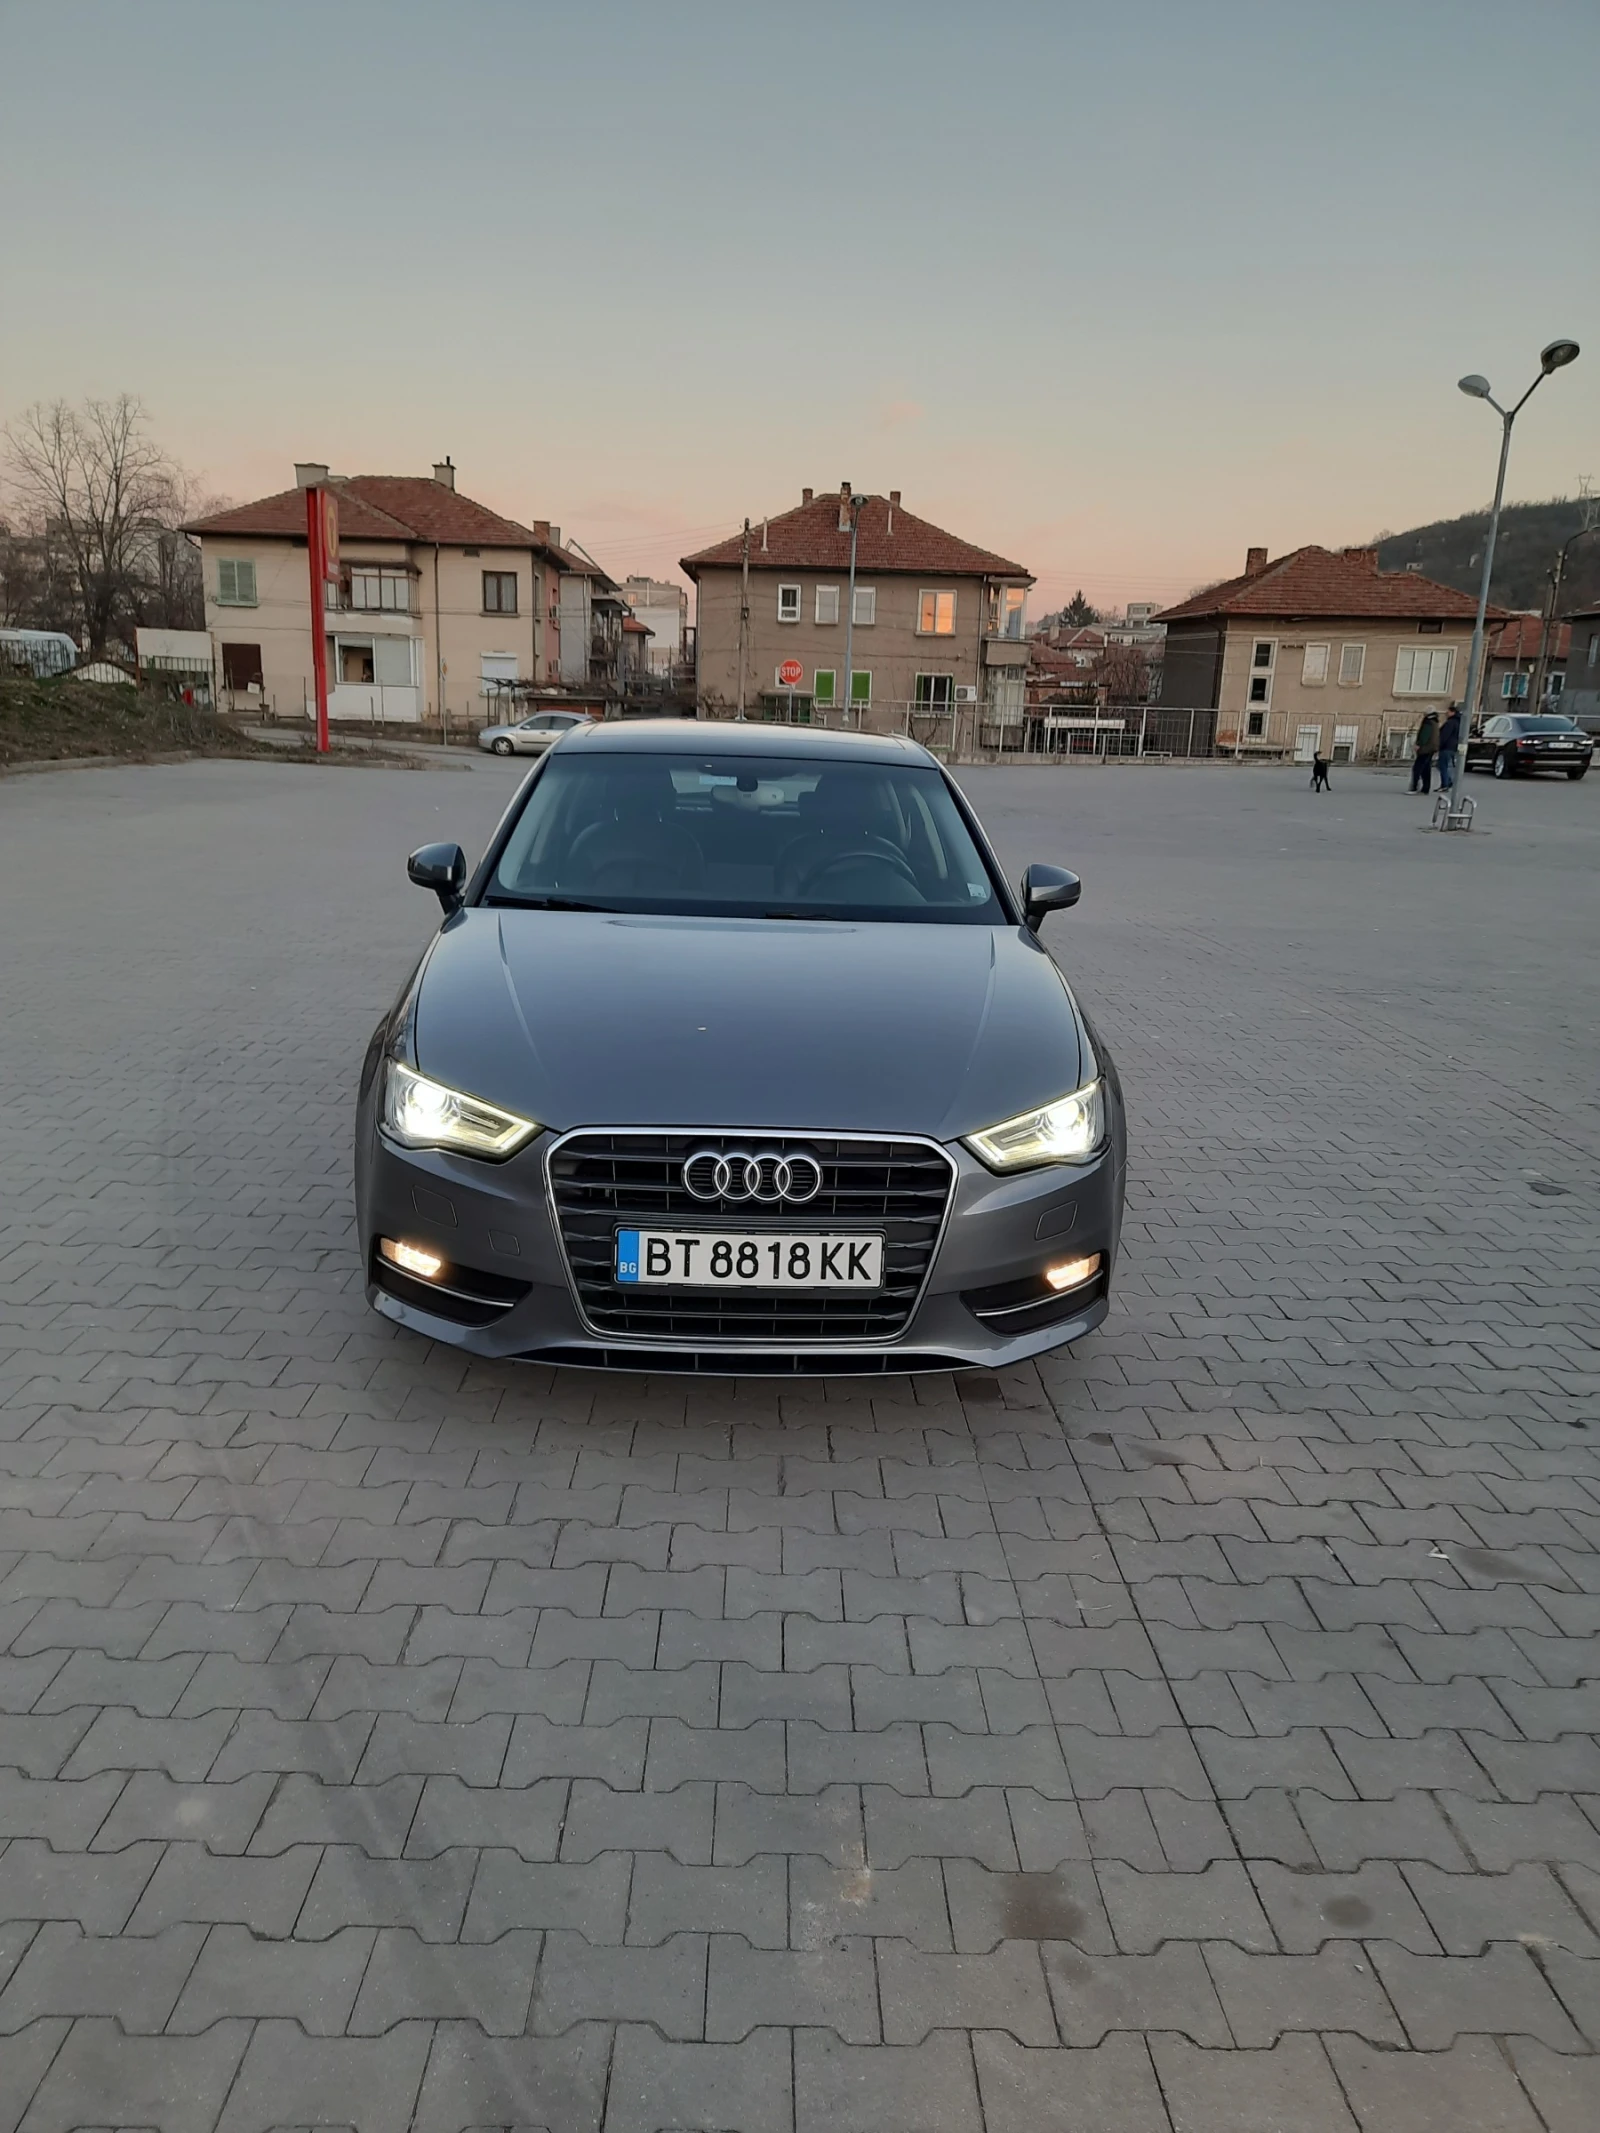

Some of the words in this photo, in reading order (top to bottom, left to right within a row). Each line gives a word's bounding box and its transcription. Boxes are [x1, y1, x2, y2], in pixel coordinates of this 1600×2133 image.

[781, 666, 800, 677] STOP
[646, 1237, 700, 1278] BT
[710, 1240, 811, 1280] 8818
[820, 1242, 872, 1280] KK
[619, 1261, 637, 1273] BG
